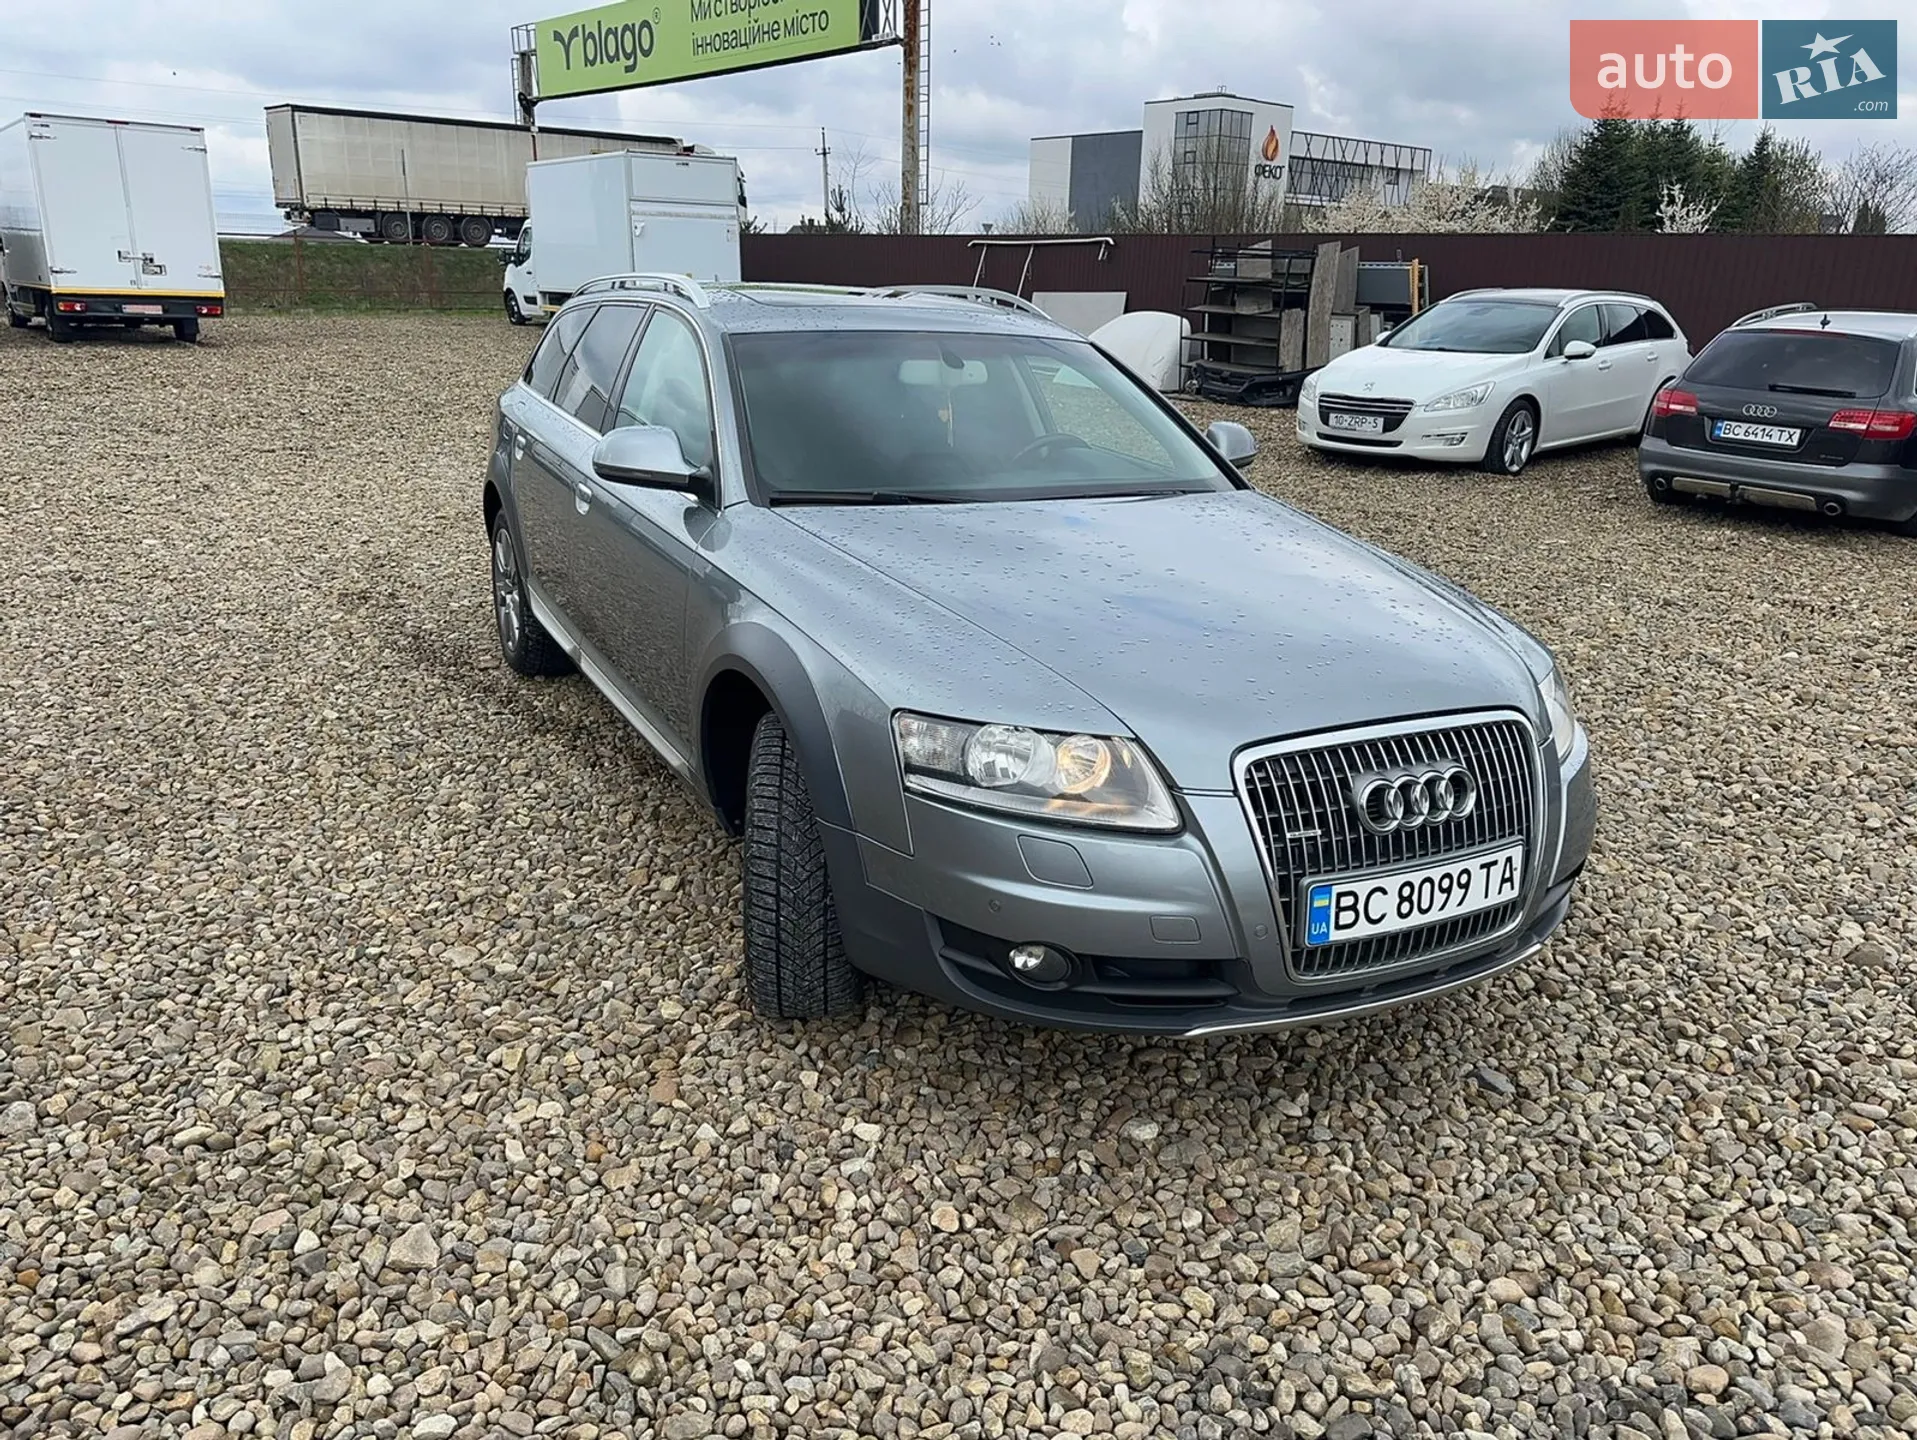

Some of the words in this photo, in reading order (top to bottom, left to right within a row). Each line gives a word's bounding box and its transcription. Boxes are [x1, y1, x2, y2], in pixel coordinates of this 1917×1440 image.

[692, 19, 780, 56] інноваційне
[784, 9, 829, 38] місто
[1722, 423, 1741, 436] BC
[1743, 425, 1773, 440] 6414
[1777, 429, 1796, 443] TX
[1335, 886, 1388, 931] BC
[1396, 868, 1471, 919] 8099
[1479, 856, 1515, 899] TA
[1311, 921, 1328, 935] UA
